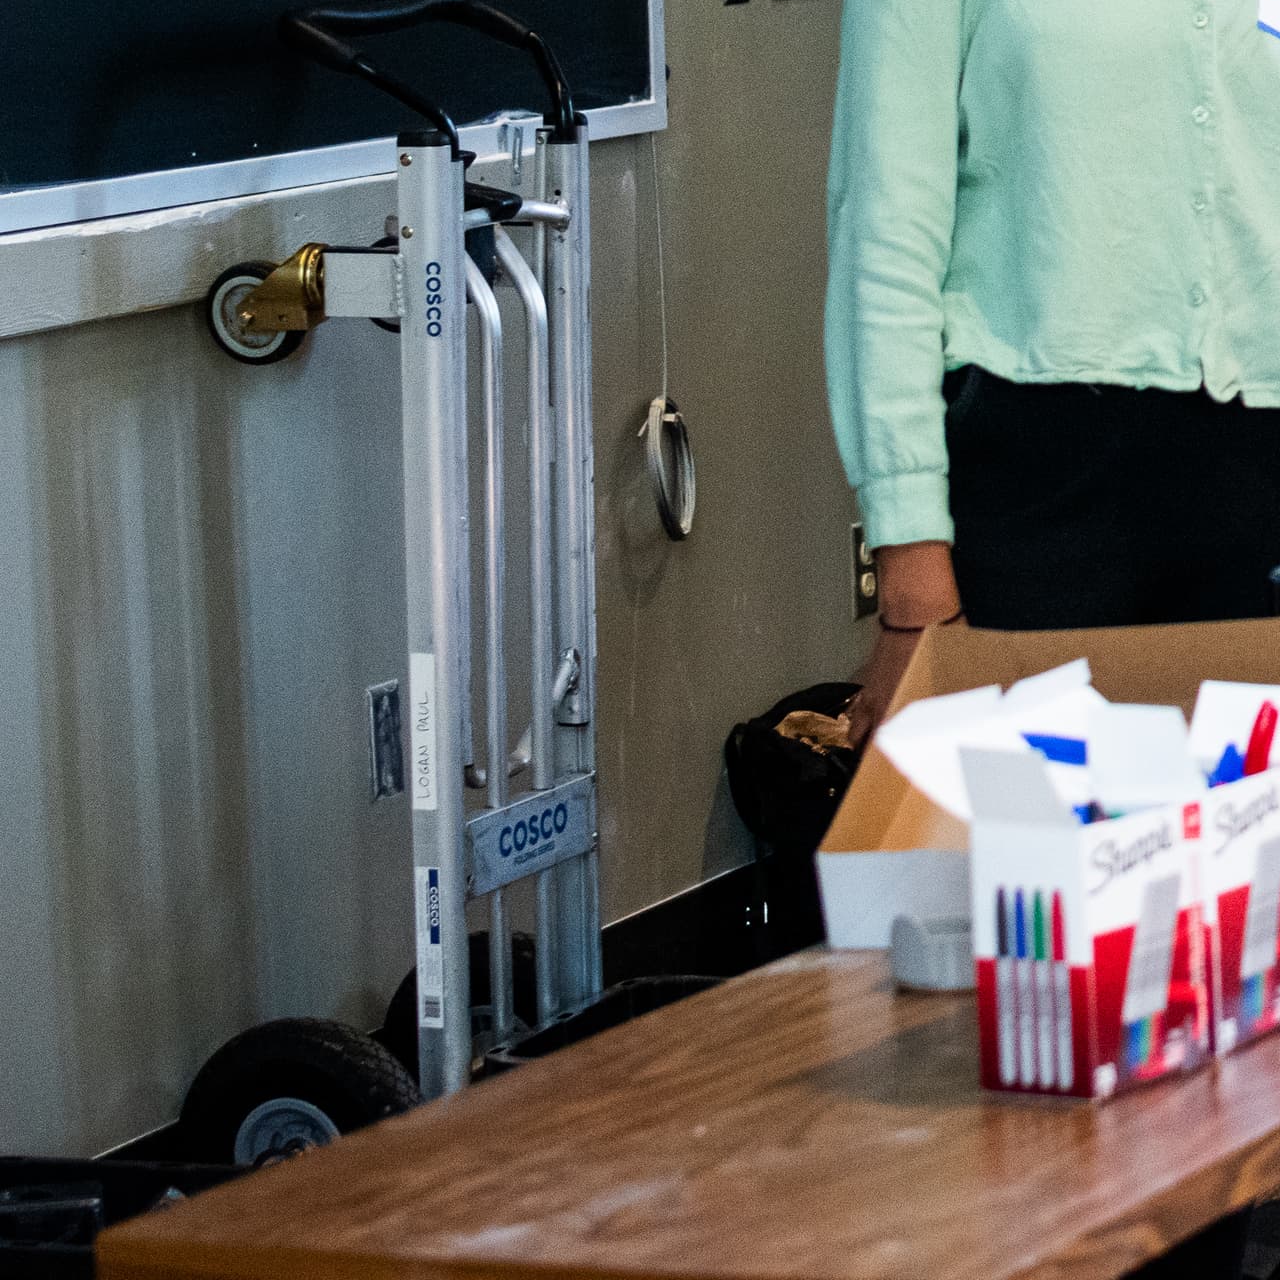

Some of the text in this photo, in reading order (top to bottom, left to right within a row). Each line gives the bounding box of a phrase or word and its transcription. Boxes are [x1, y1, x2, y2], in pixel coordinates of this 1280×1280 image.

[426, 261, 442, 338] COSCO
[416, 690, 431, 799] LOGAN PAUL
[499, 802, 568, 857] COSCO
[430, 886, 440, 927] COSCO
